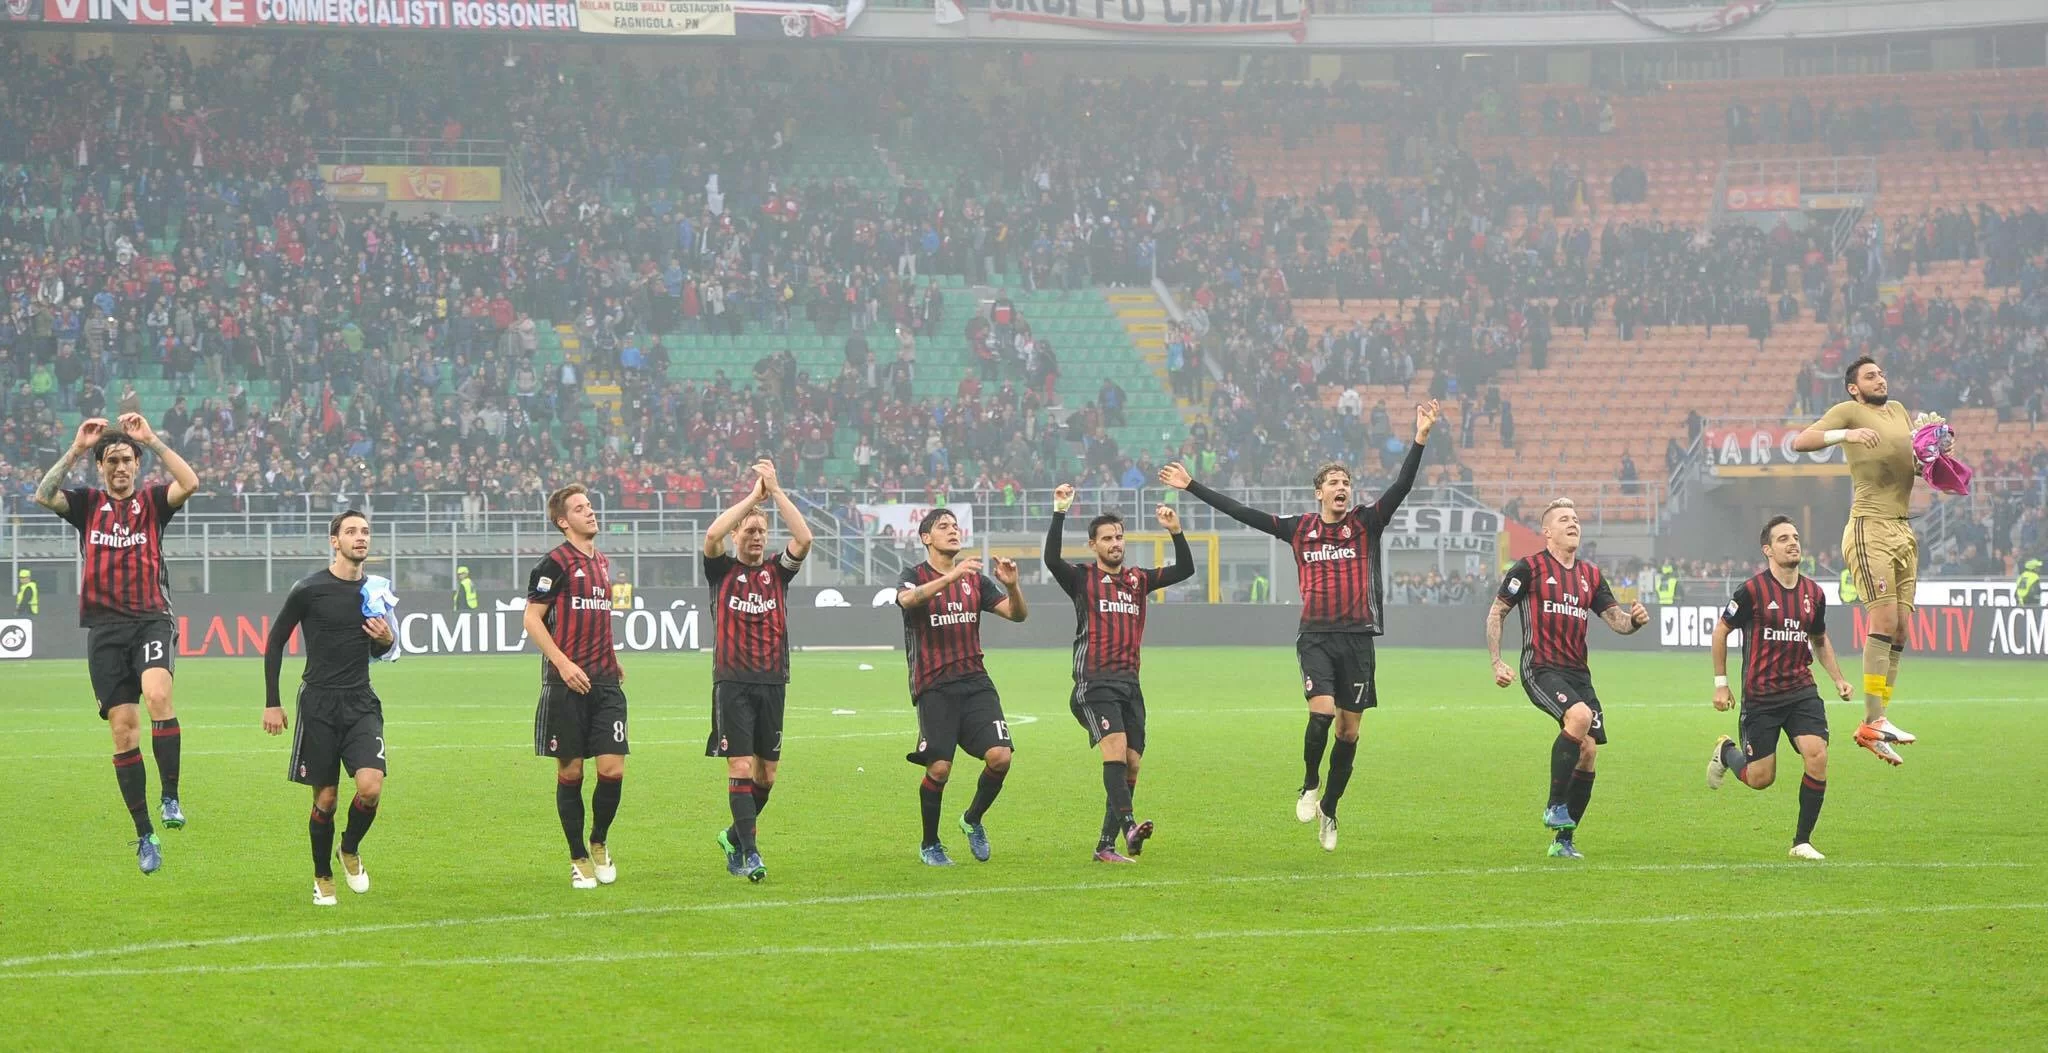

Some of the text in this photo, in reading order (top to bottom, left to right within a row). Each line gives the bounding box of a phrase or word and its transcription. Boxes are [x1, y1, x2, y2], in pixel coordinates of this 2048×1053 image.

[256, 0, 447, 26] COMMERCIALISTI
[453, 0, 577, 27] ROSSONERI
[614, 1, 638, 11] CLUB
[614, 16, 674, 28] FAGNIGOLA
[684, 18, 700, 29] PN
[113, 522, 130, 536] Fly
[90, 529, 148, 548] Emirates
[1434, 536, 1494, 551] CLUB
[1303, 547, 1356, 563] Emirates
[592, 586, 605, 598] Fly
[748, 592, 762, 605] Fly
[1117, 591, 1132, 602] Fly
[1563, 593, 1579, 606] Fly
[947, 601, 963, 612] Fly
[930, 611, 977, 627] Emirates
[1784, 618, 1800, 630] Fly
[1941, 607, 1974, 653] TV
[143, 640, 164, 664] 13
[613, 720, 628, 743] 8
[992, 720, 1011, 740] 15
[375, 736, 386, 760] 2
